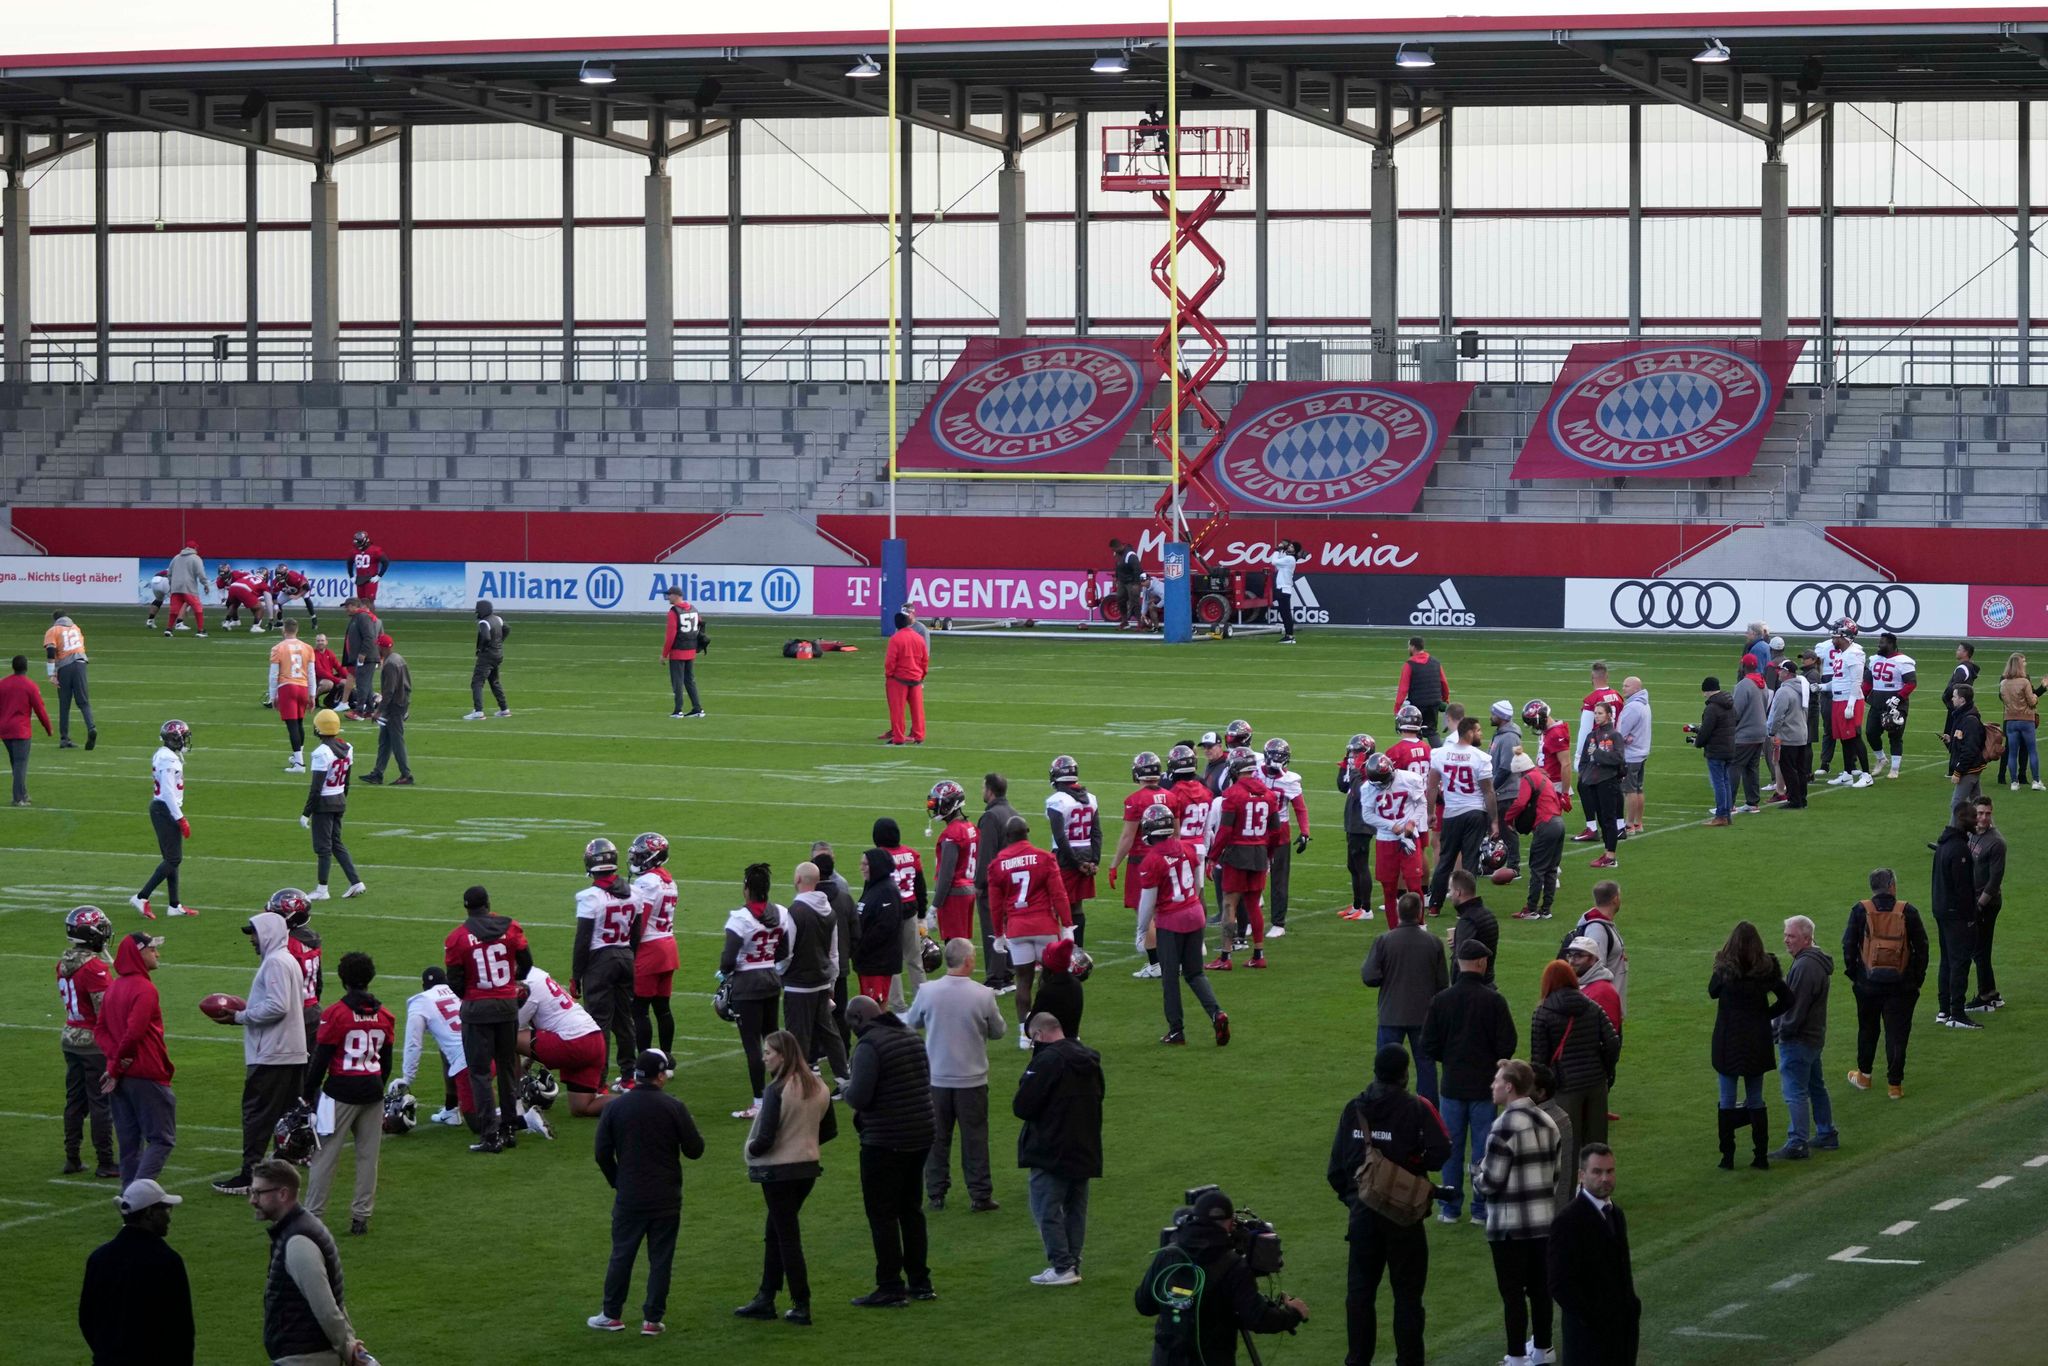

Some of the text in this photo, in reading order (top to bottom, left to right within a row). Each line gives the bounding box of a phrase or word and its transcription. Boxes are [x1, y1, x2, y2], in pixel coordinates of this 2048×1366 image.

[965, 352, 1127, 395] FC BAYERN
[1578, 353, 1755, 399] FC BAYERN
[945, 412, 1105, 455] MÜNCHEN
[1247, 396, 1421, 440] FC BAYERN
[1563, 418, 1740, 461] MÜNCHEN
[1230, 457, 1403, 502] MÜNCHEN
[355, 554, 371, 569] 60
[1321, 533, 1419, 568] mia
[27, 572, 60, 582] Nichts
[62, 572, 87, 585] liegt
[89, 573, 122, 583] näher!
[478, 571, 578, 600] Allianz
[1165, 565, 1181, 576] NFL
[649, 573, 753, 603] Allianz
[848, 577, 870, 606] T
[879, 577, 1034, 610] AGENTA
[680, 612, 700, 633] 57
[1265, 606, 1330, 624] adas
[1409, 608, 1476, 627] adidas
[62, 630, 81, 651] 12
[1873, 662, 1896, 682] 95
[1444, 765, 1475, 794] 79
[1180, 802, 1210, 837] 29
[1242, 801, 1269, 837] 13
[1376, 791, 1408, 821] 27
[1068, 807, 1093, 841] 22
[966, 842, 977, 879] 6
[1010, 870, 1031, 908] 7
[1168, 860, 1195, 902] 14
[602, 904, 636, 944] 53
[473, 943, 511, 989] 16
[342, 1029, 387, 1073] 80
[1371, 1130, 1392, 1141] MEDIA
